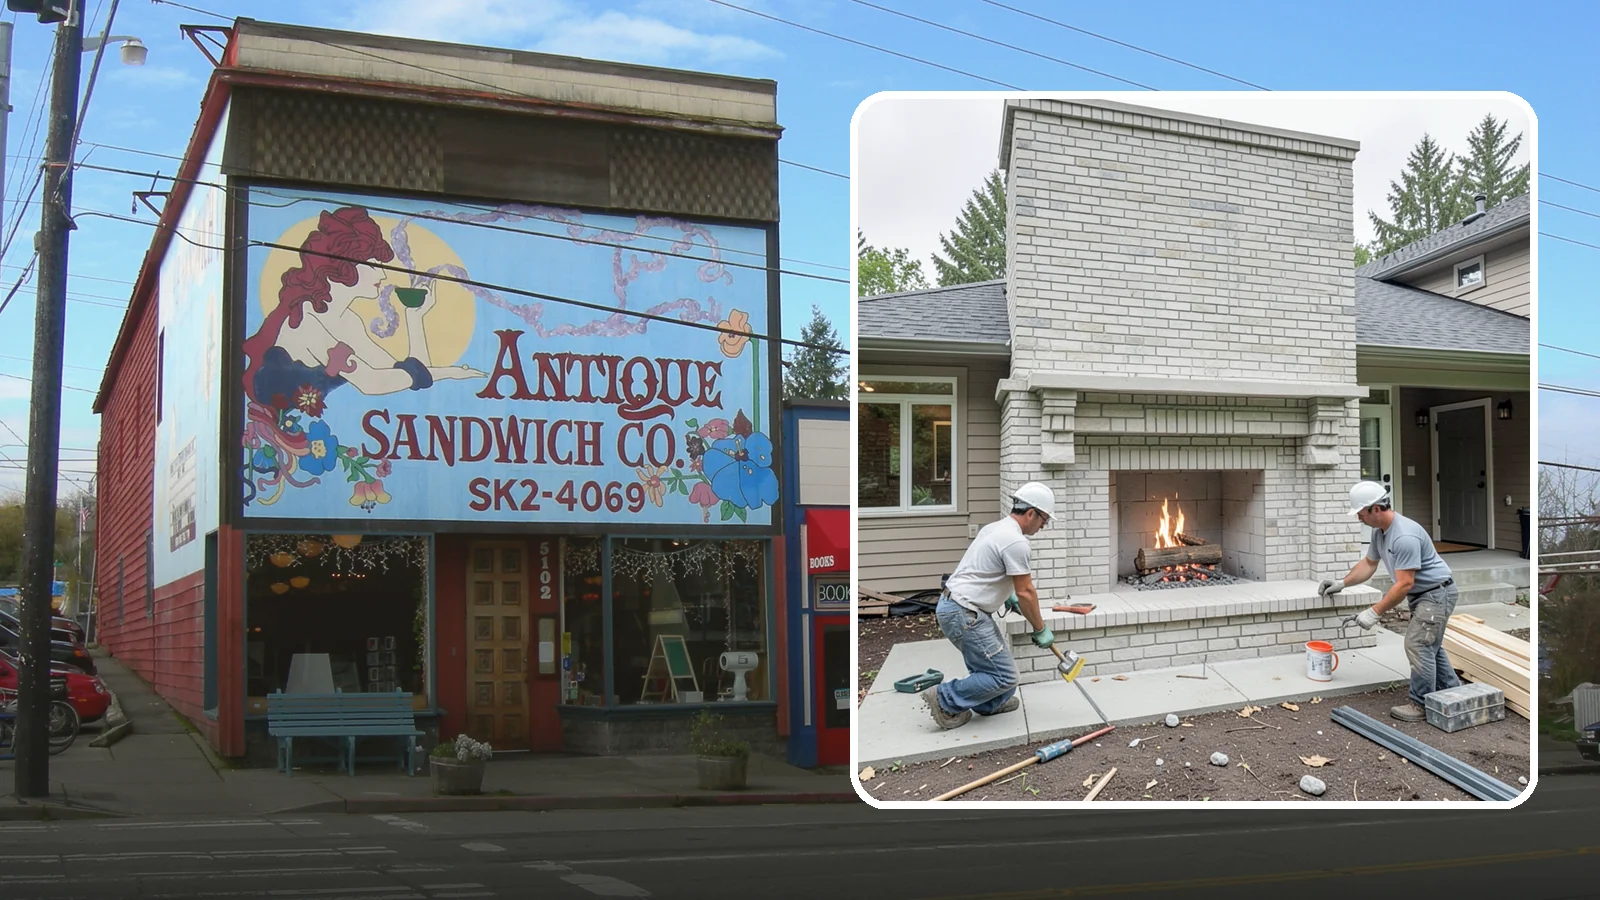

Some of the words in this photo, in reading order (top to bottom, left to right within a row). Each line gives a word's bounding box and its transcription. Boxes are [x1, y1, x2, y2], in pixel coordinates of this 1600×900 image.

[476, 329, 724, 420] ANTIQUE
[361, 409, 604, 467] SANDWICH
[617, 422, 685, 469] CO.
[468, 477, 647, 513] SK2-4069
[540, 541, 552, 599] 5102
[810, 555, 835, 569] BOOKS
